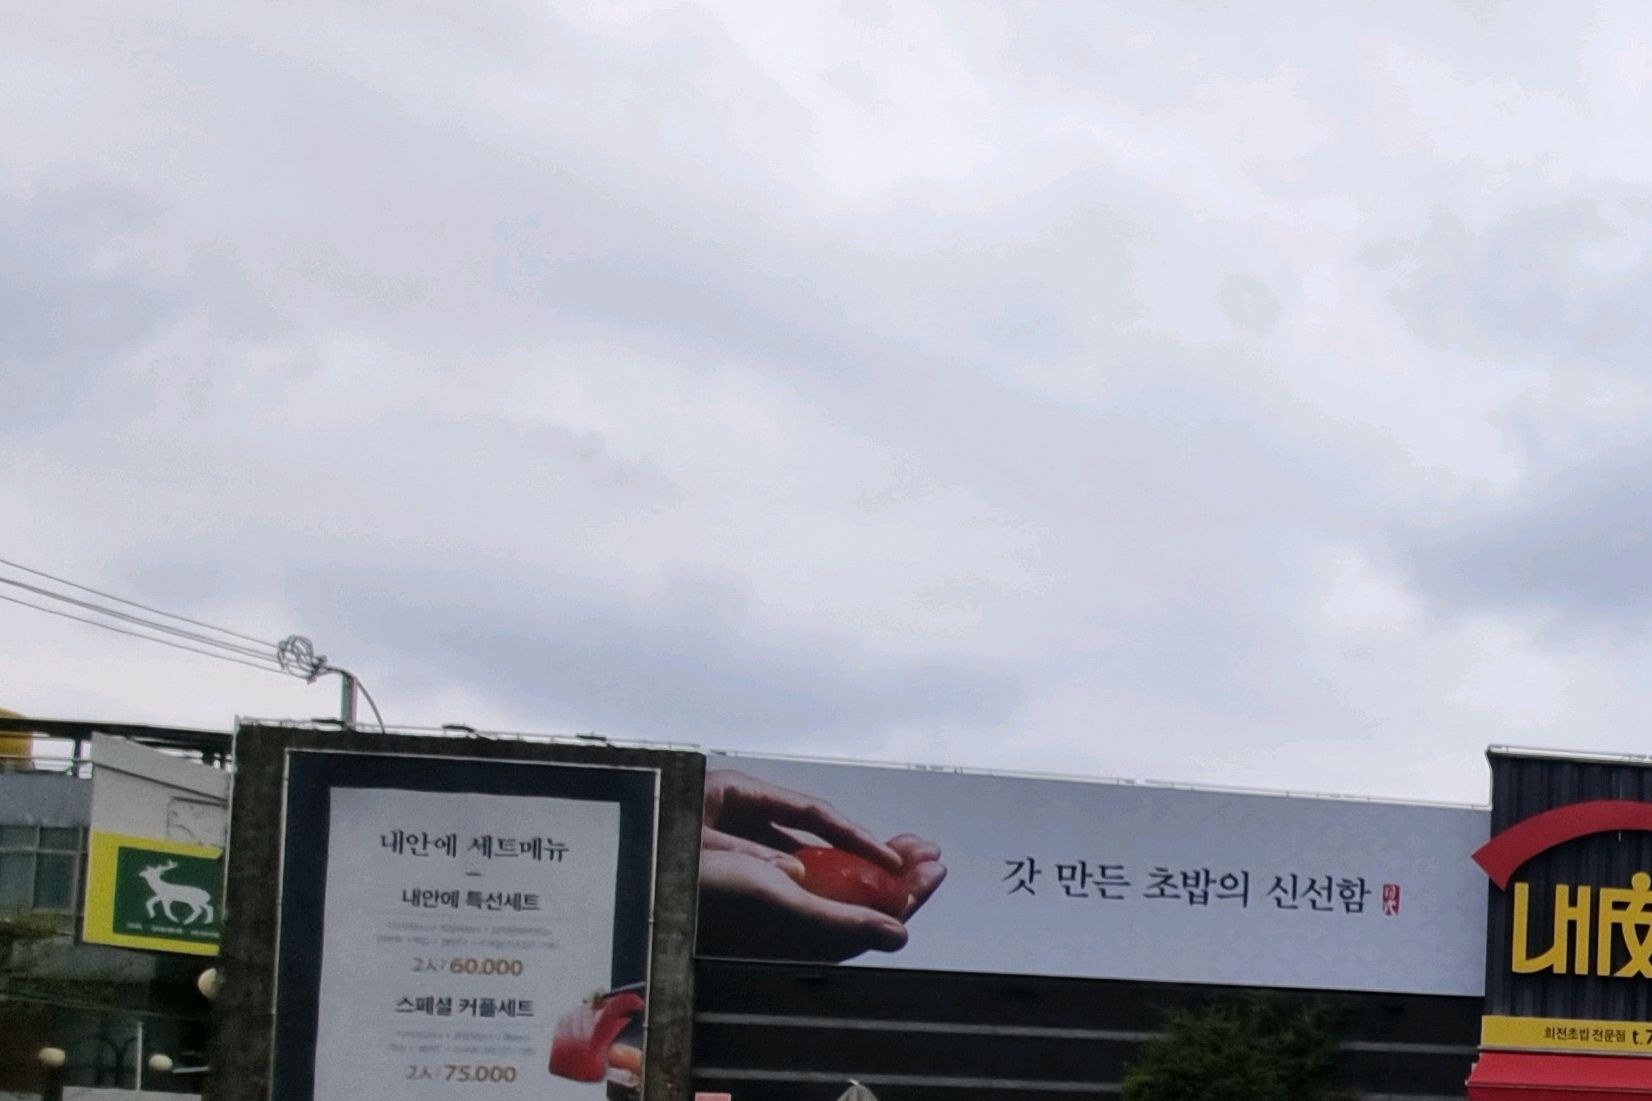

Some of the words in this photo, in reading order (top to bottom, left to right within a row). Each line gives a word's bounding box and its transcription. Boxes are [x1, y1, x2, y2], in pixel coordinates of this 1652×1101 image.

[379, 830, 458, 858] 내안에
[467, 834, 570, 863] 세트메뉴
[1002, 857, 1042, 897] 갓
[1054, 860, 1132, 900] 만든
[1143, 866, 1250, 909] 초밥의
[1265, 875, 1372, 915] 신선함
[402, 888, 459, 909] 내안에
[466, 890, 541, 911] 특선세트
[395, 996, 452, 1017] 스페셜
[459, 998, 535, 1018] 커플세트
[1544, 1026, 1589, 1042] 회전초밥
[1592, 1028, 1626, 1043] 전문점
